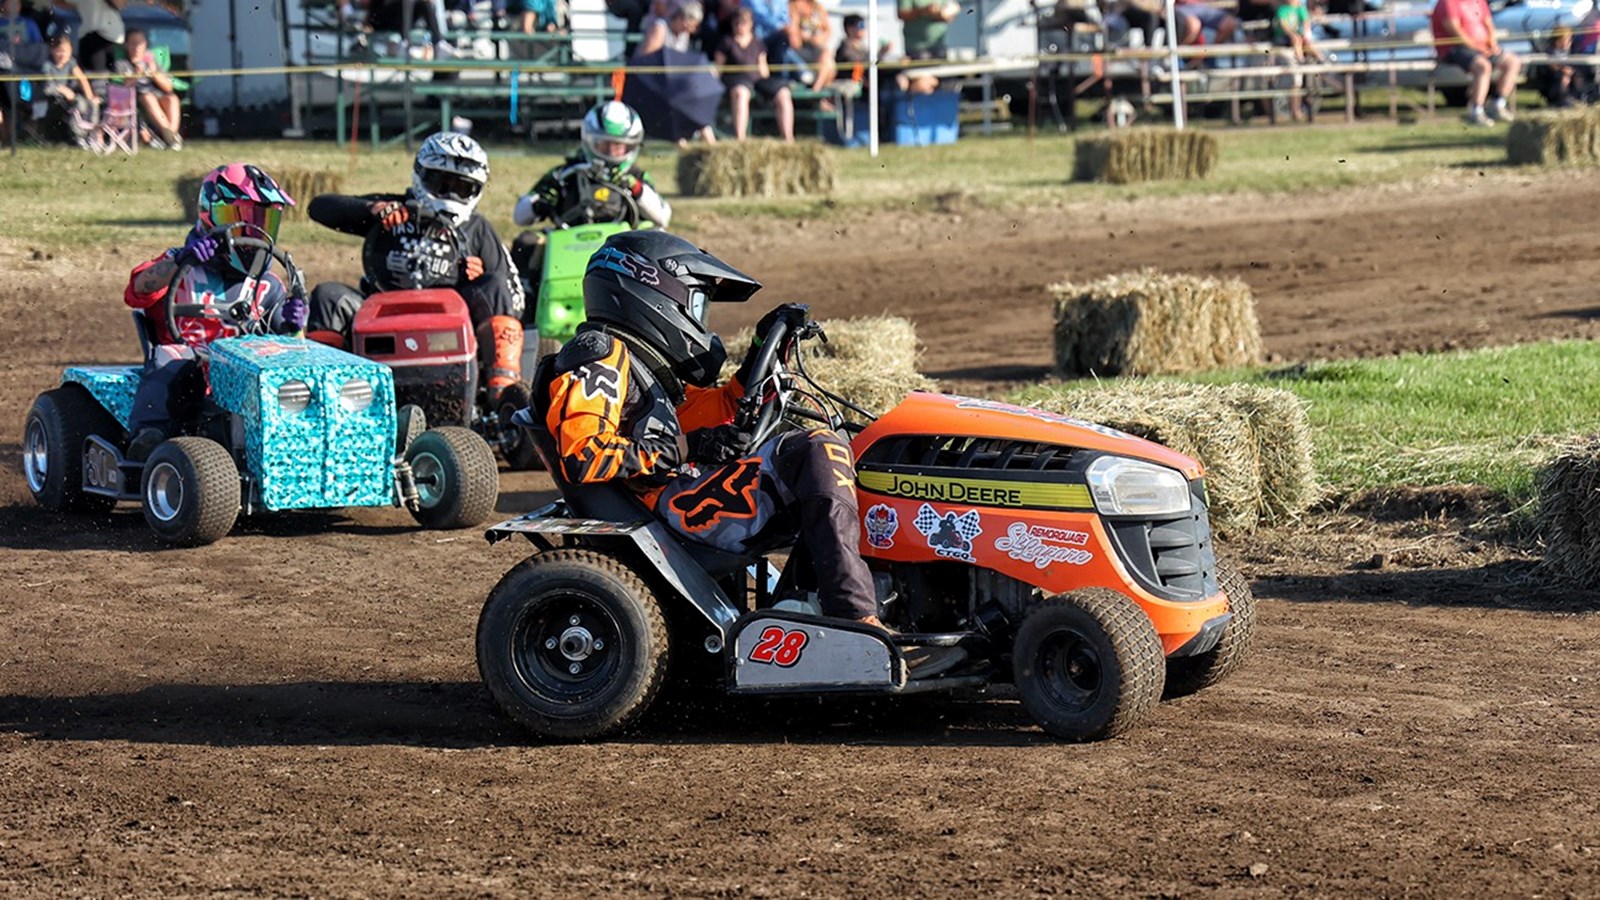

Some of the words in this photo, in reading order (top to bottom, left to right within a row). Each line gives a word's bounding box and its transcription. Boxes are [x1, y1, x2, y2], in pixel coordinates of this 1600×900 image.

[887, 476, 944, 498] JOHN
[949, 482, 1021, 503] DEERE
[1030, 526, 1087, 544] REMORQUAGE
[749, 625, 809, 668] 28
